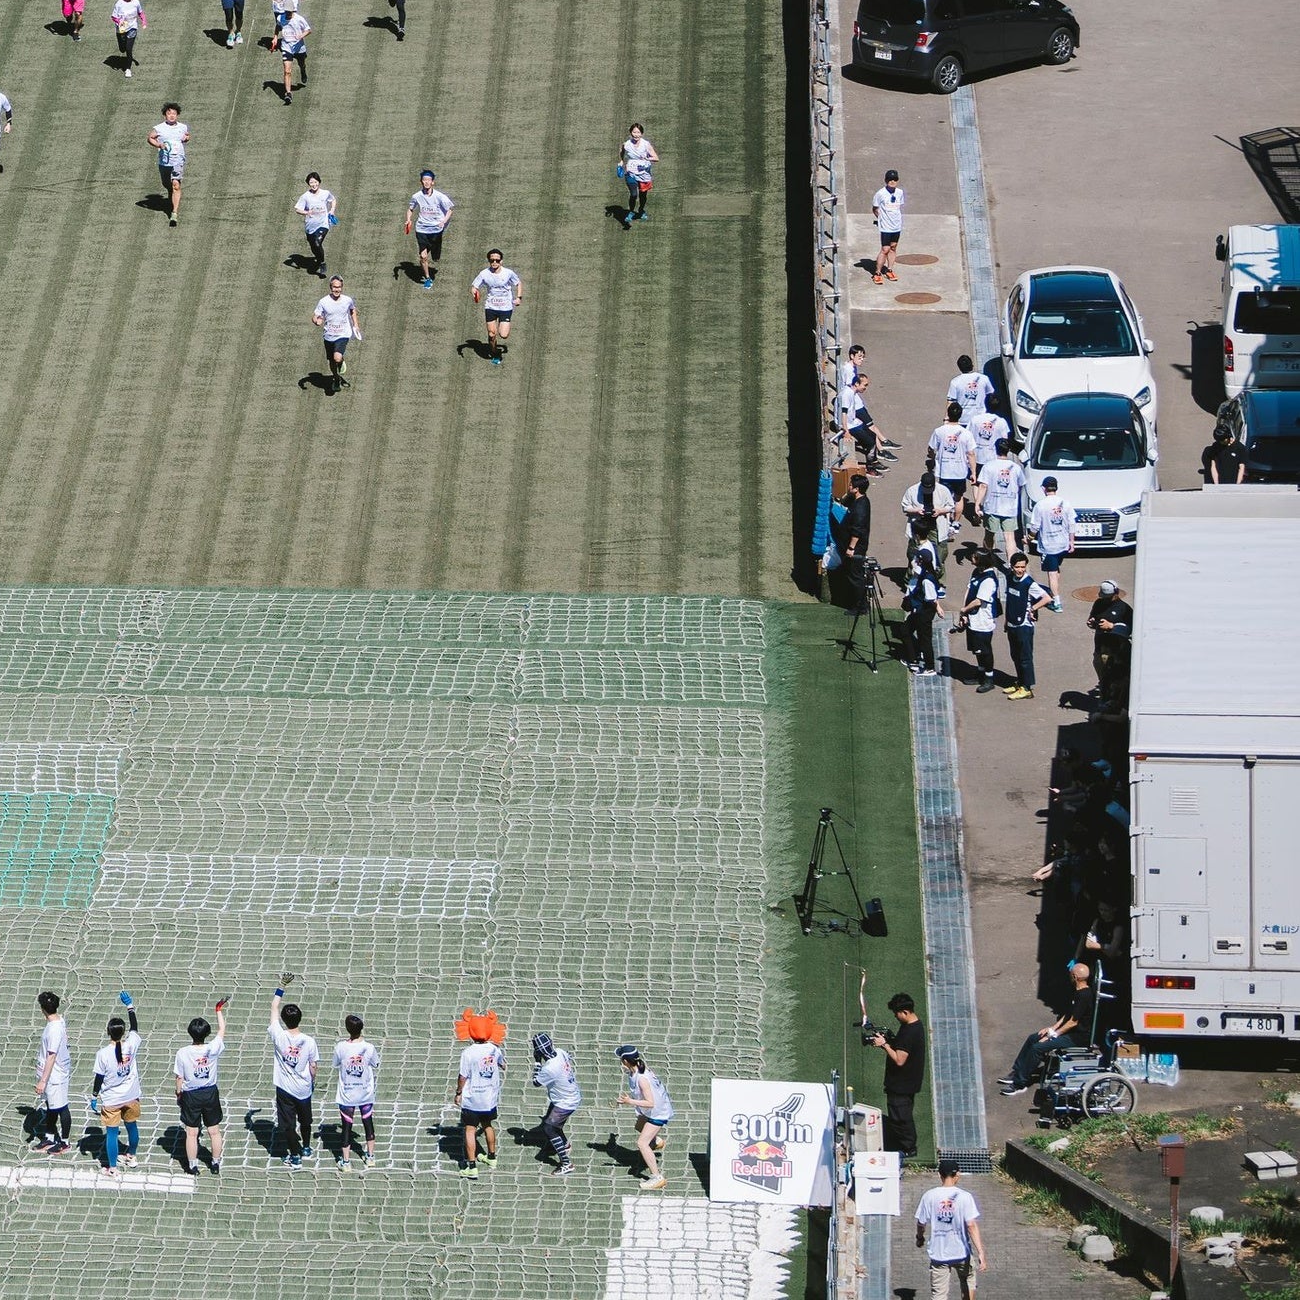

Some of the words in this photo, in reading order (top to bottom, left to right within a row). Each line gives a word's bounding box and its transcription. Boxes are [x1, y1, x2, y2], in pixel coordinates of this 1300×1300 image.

[730, 1113, 813, 1143] 300m
[731, 1159, 762, 1176] Red
[762, 1160, 793, 1178] Bull
